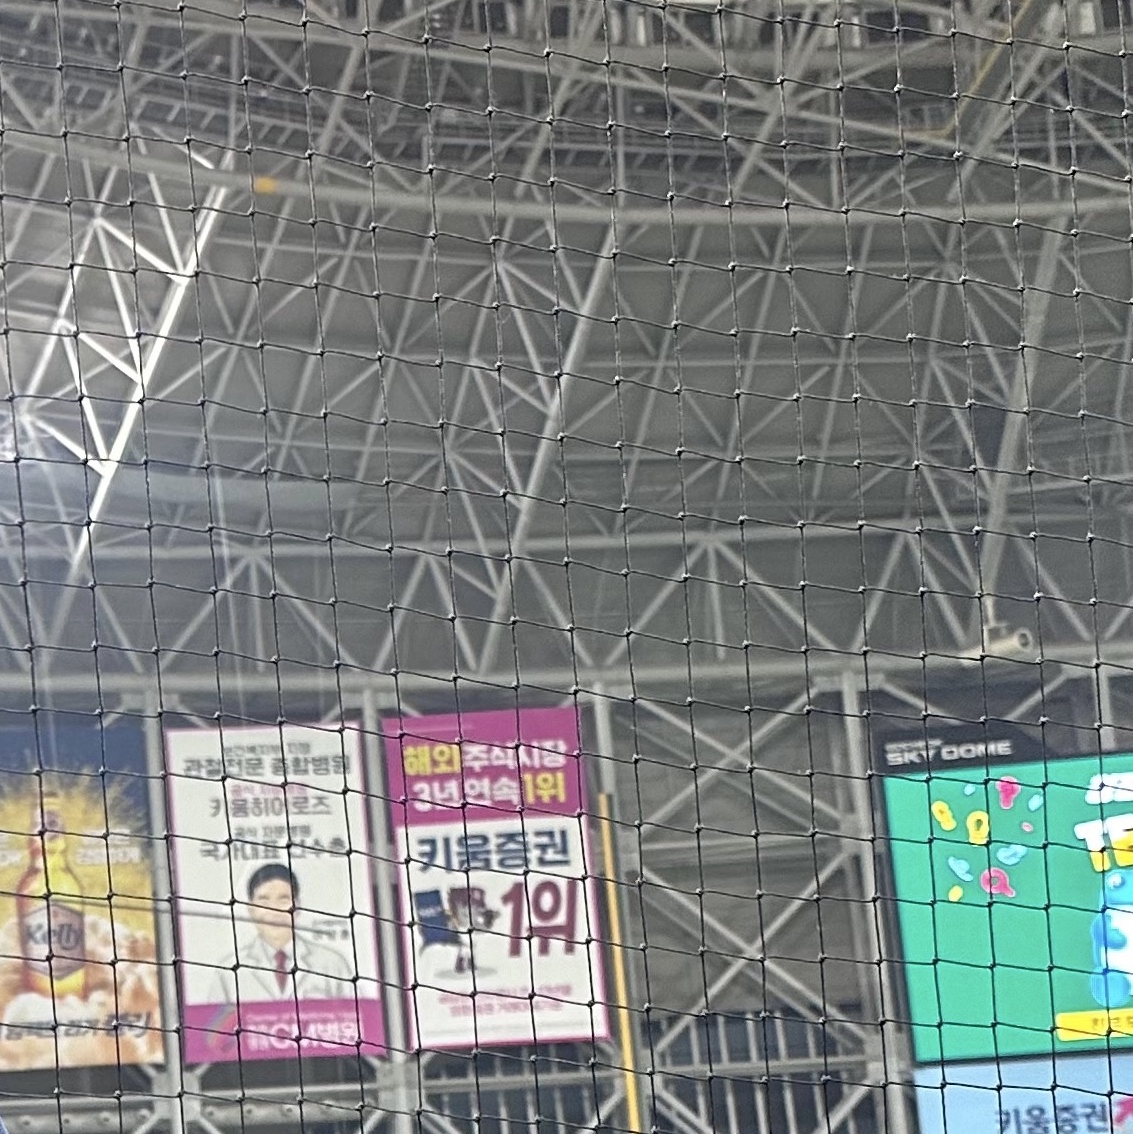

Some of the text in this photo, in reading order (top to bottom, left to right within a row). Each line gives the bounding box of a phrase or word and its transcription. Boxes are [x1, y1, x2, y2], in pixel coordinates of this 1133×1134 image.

[886, 750, 935, 766] SKY
[941, 739, 1013, 760] DOME
[417, 829, 570, 874] 키움증권
[501, 880, 579, 957] 1위
